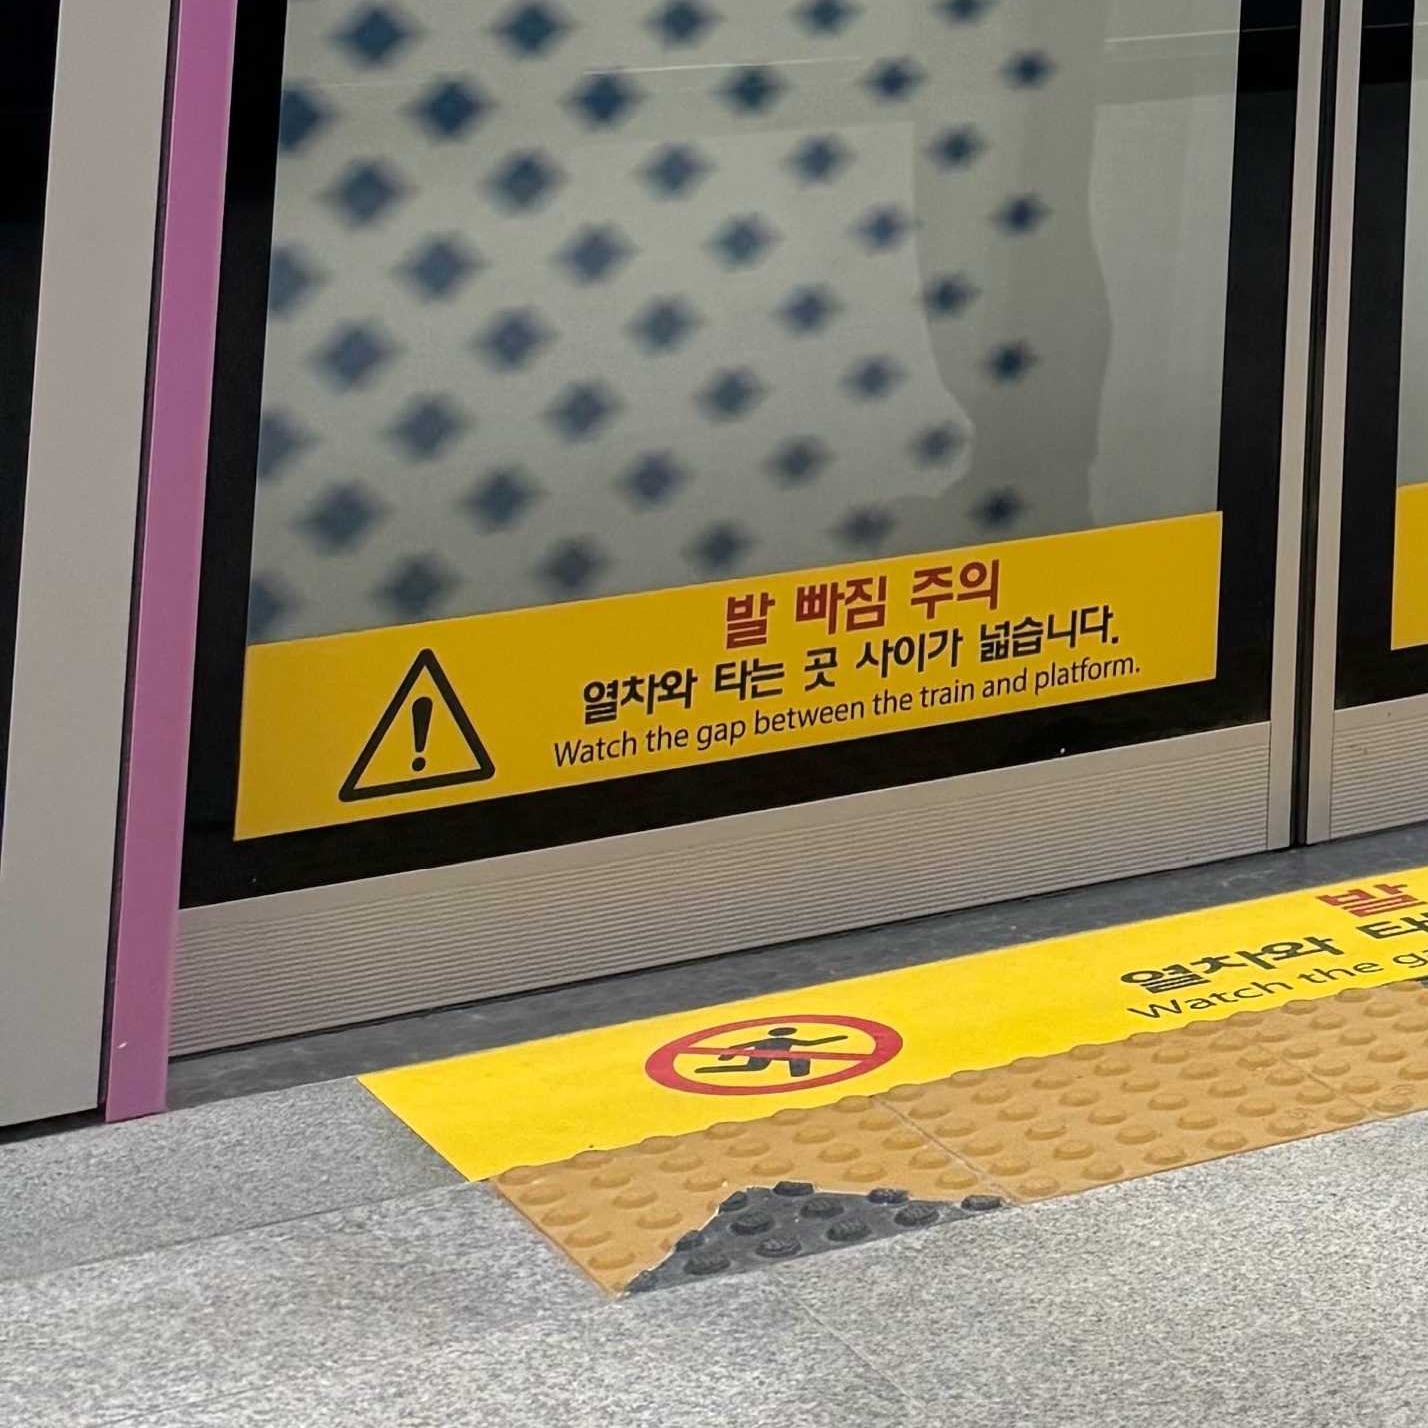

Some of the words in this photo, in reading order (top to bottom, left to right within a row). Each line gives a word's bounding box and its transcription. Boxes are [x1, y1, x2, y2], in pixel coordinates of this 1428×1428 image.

[726, 592, 775, 650] 발
[795, 575, 887, 636] 빠짐
[910, 559, 1000, 620] 주의
[583, 668, 698, 725] 열차와
[714, 658, 785, 701] 타는
[804, 646, 838, 692] 곳
[855, 628, 963, 678] 사이가
[980, 604, 1119, 663] 넓습니다.
[554, 730, 637, 767] Watch
[646, 725, 689, 753] the
[697, 720, 746, 751] gap
[754, 700, 865, 735] between
[873, 689, 913, 716] the
[919, 679, 975, 708] train
[981, 667, 1028, 699] and
[1035, 656, 1140, 696] platform.
[1316, 883, 1428, 918] 발
[1120, 936, 1345, 994] 열차와
[1127, 980, 1294, 1019] Watch
[1298, 961, 1385, 985] the
